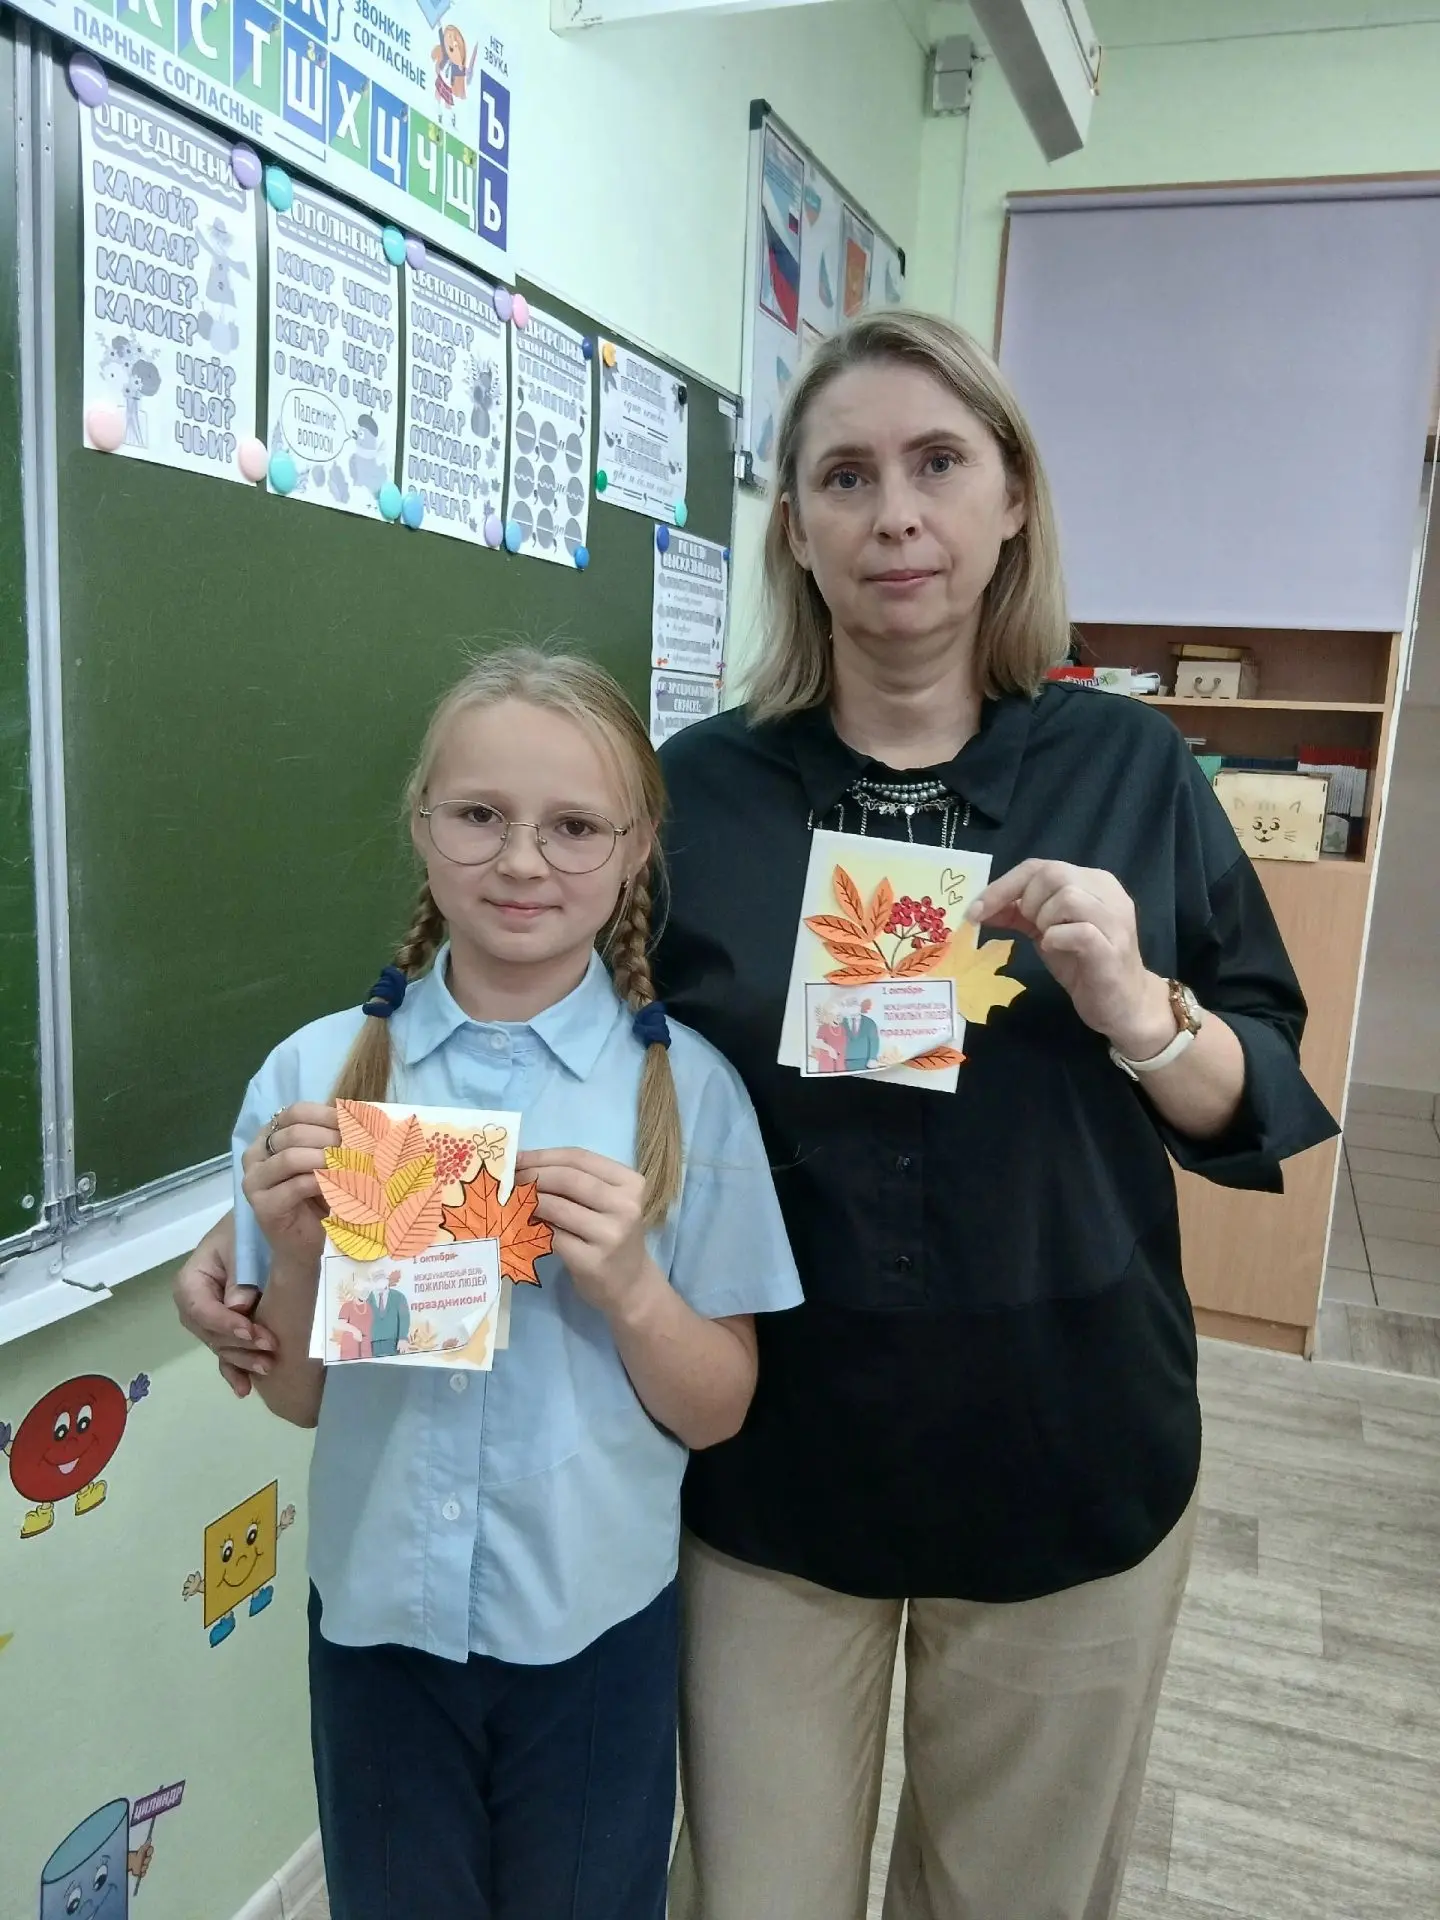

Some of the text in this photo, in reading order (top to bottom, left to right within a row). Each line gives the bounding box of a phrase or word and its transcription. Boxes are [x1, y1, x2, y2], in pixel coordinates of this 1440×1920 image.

[353, 0, 412, 51] ЗВОНКИЕ
[489, 35, 505, 57] НЕТ
[73, 6, 263, 136] ПАРНЫЕ СОГЛАСНЫЕ
[353, 22, 427, 90] СОГЛАСНЫЕ
[484, 46, 509, 77] ЗВУКА
[94, 101, 240, 190] ОПРЕДЕЛЕНИ
[245, 19, 272, 88] Т
[287, 47, 324, 125] Ш
[336, 79, 362, 149] Х
[376, 106, 402, 186] Ц
[416, 132, 438, 195] Ч
[446, 152, 475, 230] Щ
[482, 91, 505, 150] Ъ
[93, 160, 199, 231] КАКОЙ?
[483, 177, 502, 232] Ь
[95, 202, 200, 271] КАКАЯ?
[278, 198, 388, 268] ОПОЛНЕНИ
[96, 246, 199, 309] КАКОЕ?
[276, 246, 393, 321] КОГО? ЧЕГО?
[95, 286, 199, 347] КАКИЕ?
[276, 282, 395, 353] КОМУ? ЧЕМУ?
[411, 301, 475, 352] КОГДА?
[276, 314, 388, 381] КЕМ? ЧЕМ?
[412, 333, 456, 373] КАК?
[176, 351, 237, 398] ЧЕЙ?
[274, 350, 287, 375] О
[290, 356, 337, 393] КОМ?
[339, 374, 350, 398] О
[411, 364, 453, 402] ГДЕ?
[175, 386, 237, 430] ЧЬЯ?
[411, 394, 466, 437] КУДА?
[175, 420, 237, 463] ЧЬИ?
[409, 424, 481, 471] ОТКУДА?
[408, 454, 480, 499] ПОЧЕМУ?
[410, 1292, 487, 1313] праздником!
[414, 1275, 488, 1294] ПОЖИЛЫХ ЛЮДЕЙ
[133, 1785, 183, 1821] ЦИЛИНДР
